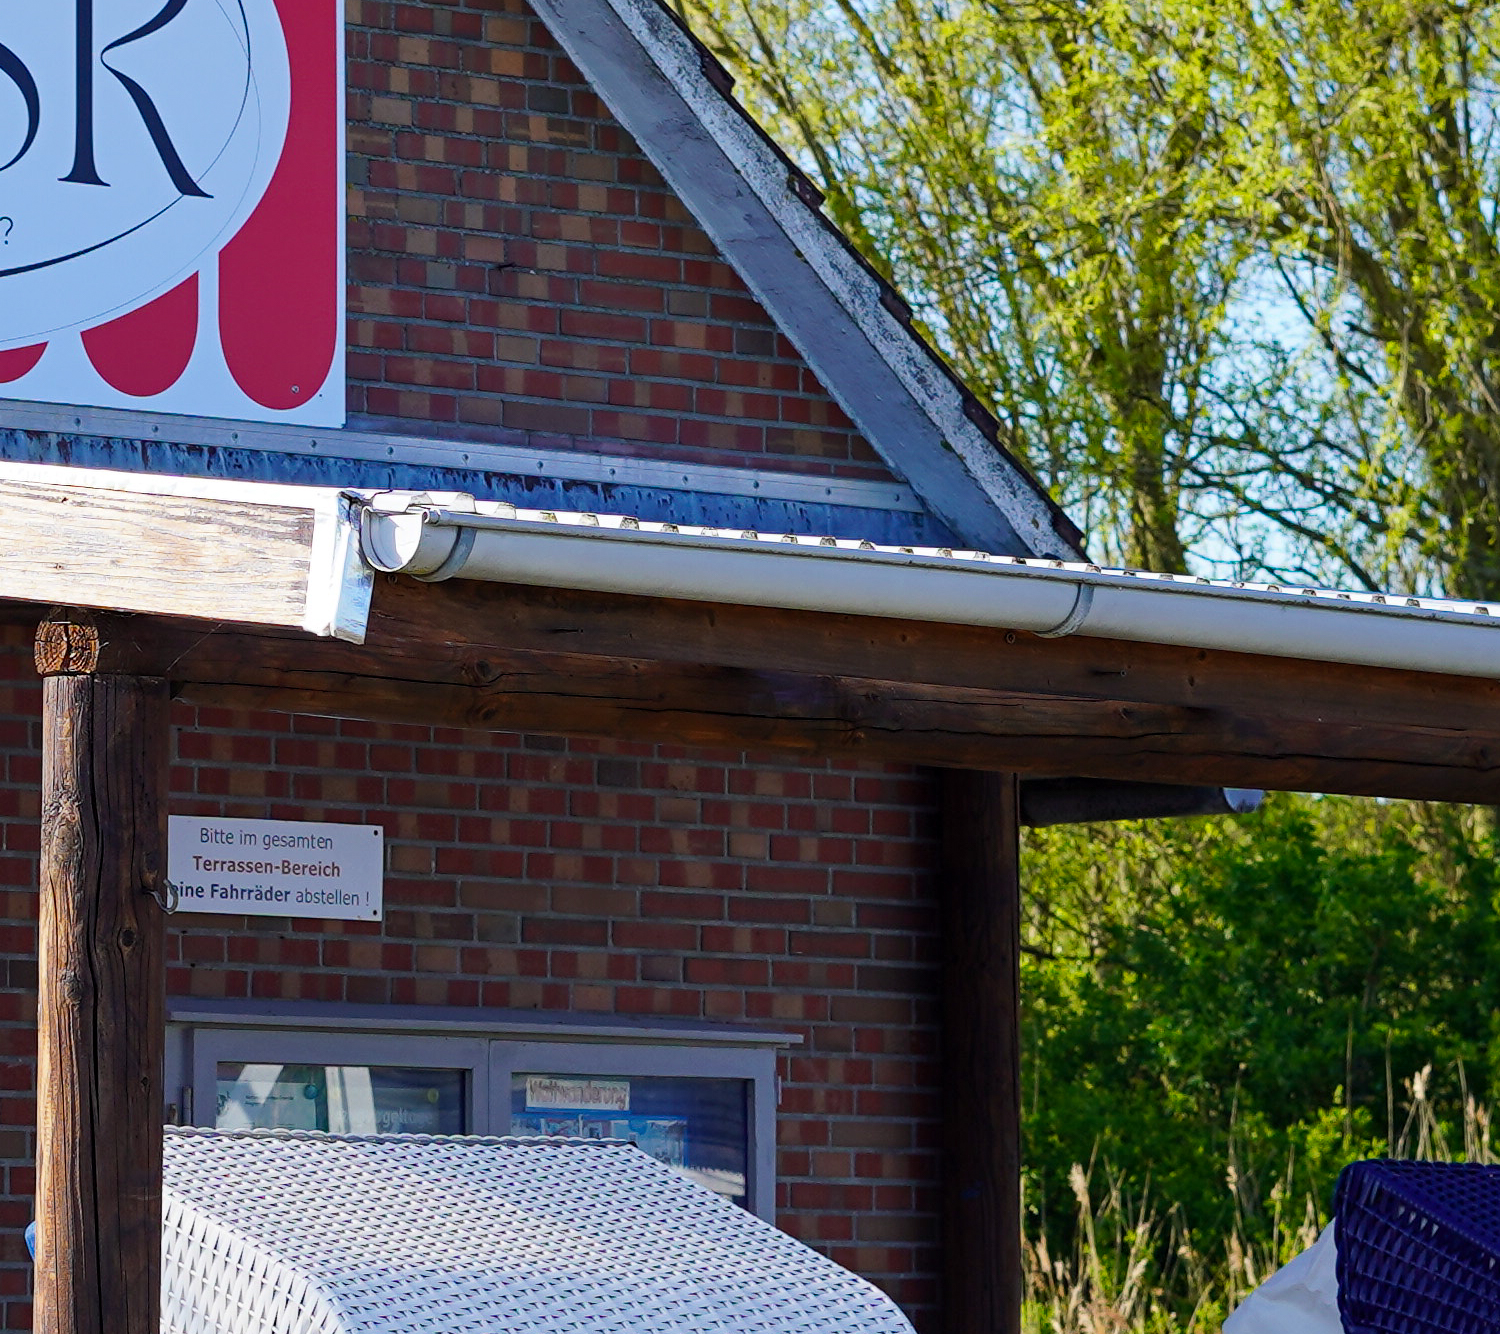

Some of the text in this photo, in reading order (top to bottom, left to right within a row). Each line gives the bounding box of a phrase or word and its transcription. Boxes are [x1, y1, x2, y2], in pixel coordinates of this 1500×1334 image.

[200, 827, 334, 851] Bitte im gesamten
[193, 855, 341, 878] Terrassen-Bereich
[170, 881, 205, 898] ine
[210, 883, 291, 903] Fahrräder
[295, 887, 360, 906] abstellen
